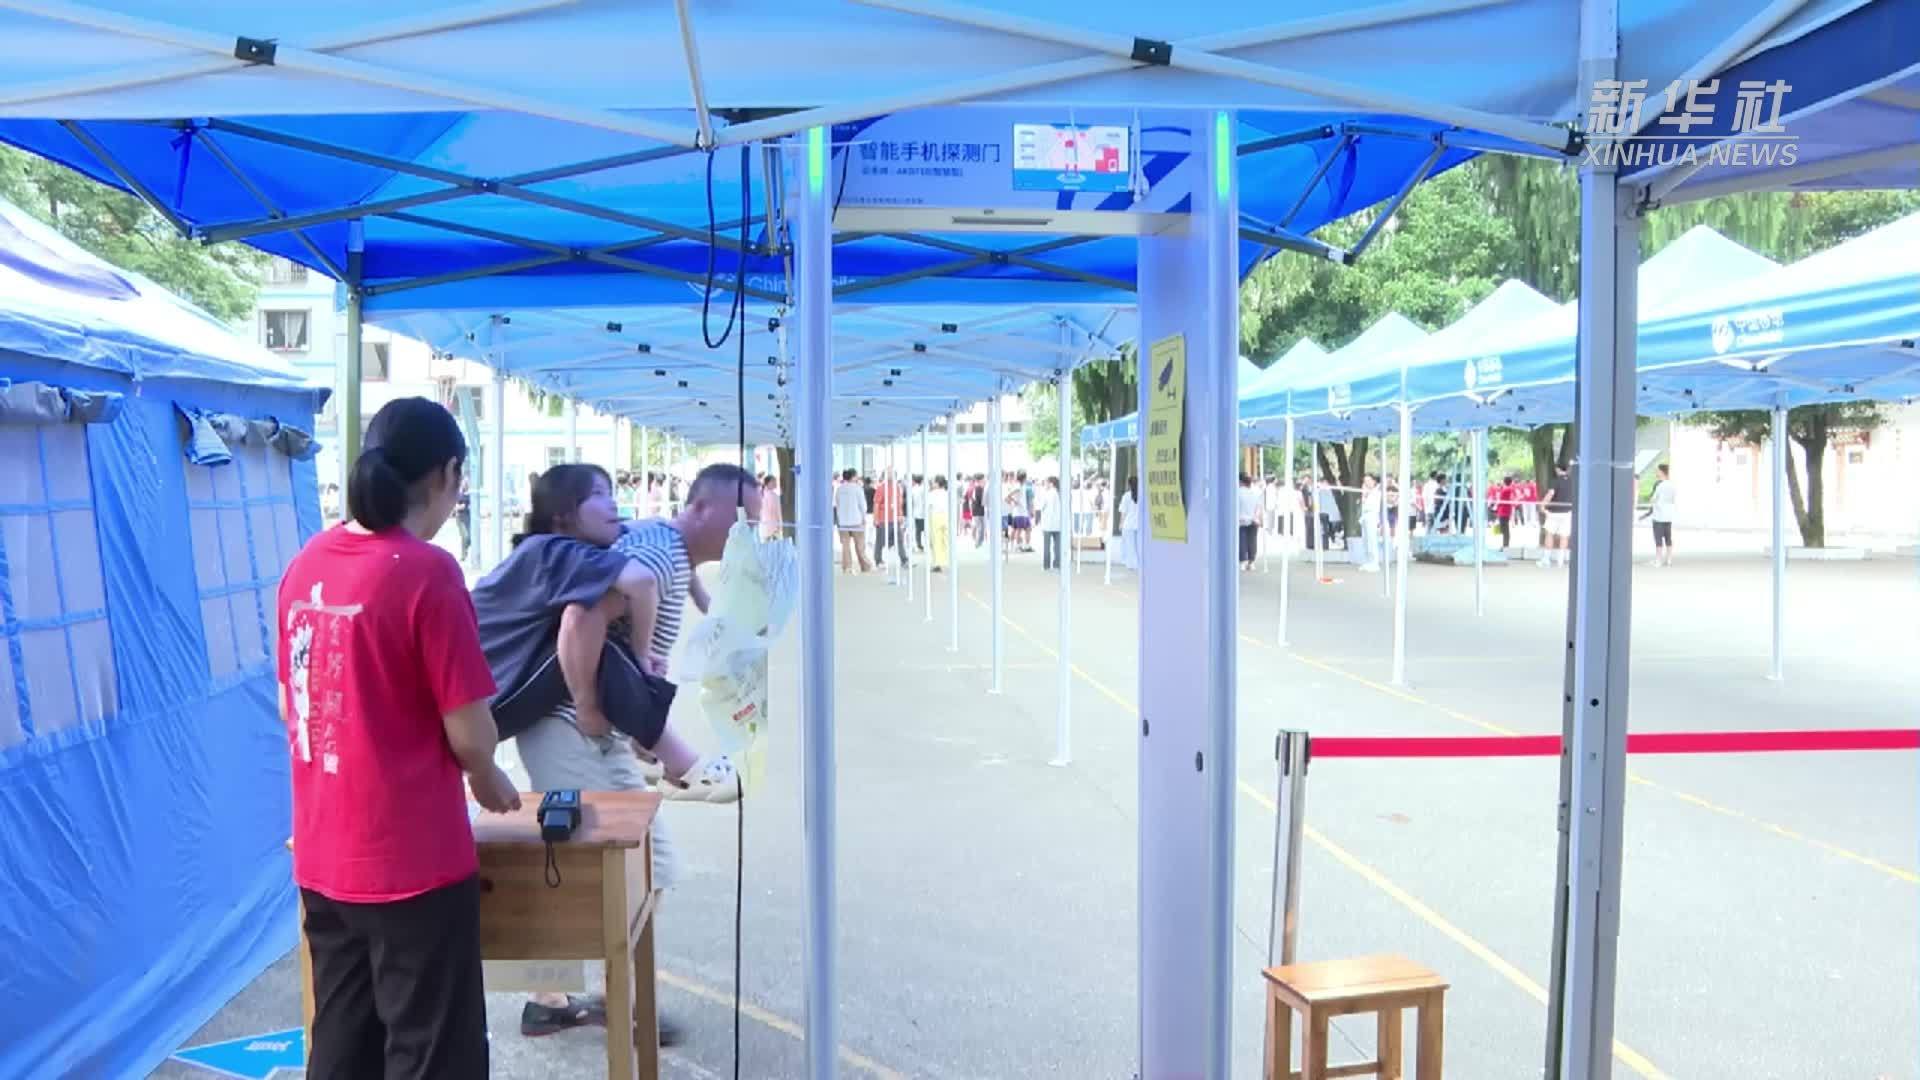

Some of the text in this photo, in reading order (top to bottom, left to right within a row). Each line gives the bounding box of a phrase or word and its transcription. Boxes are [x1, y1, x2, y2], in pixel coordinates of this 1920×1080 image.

[860, 140, 1000, 162] 智能手机探测门
